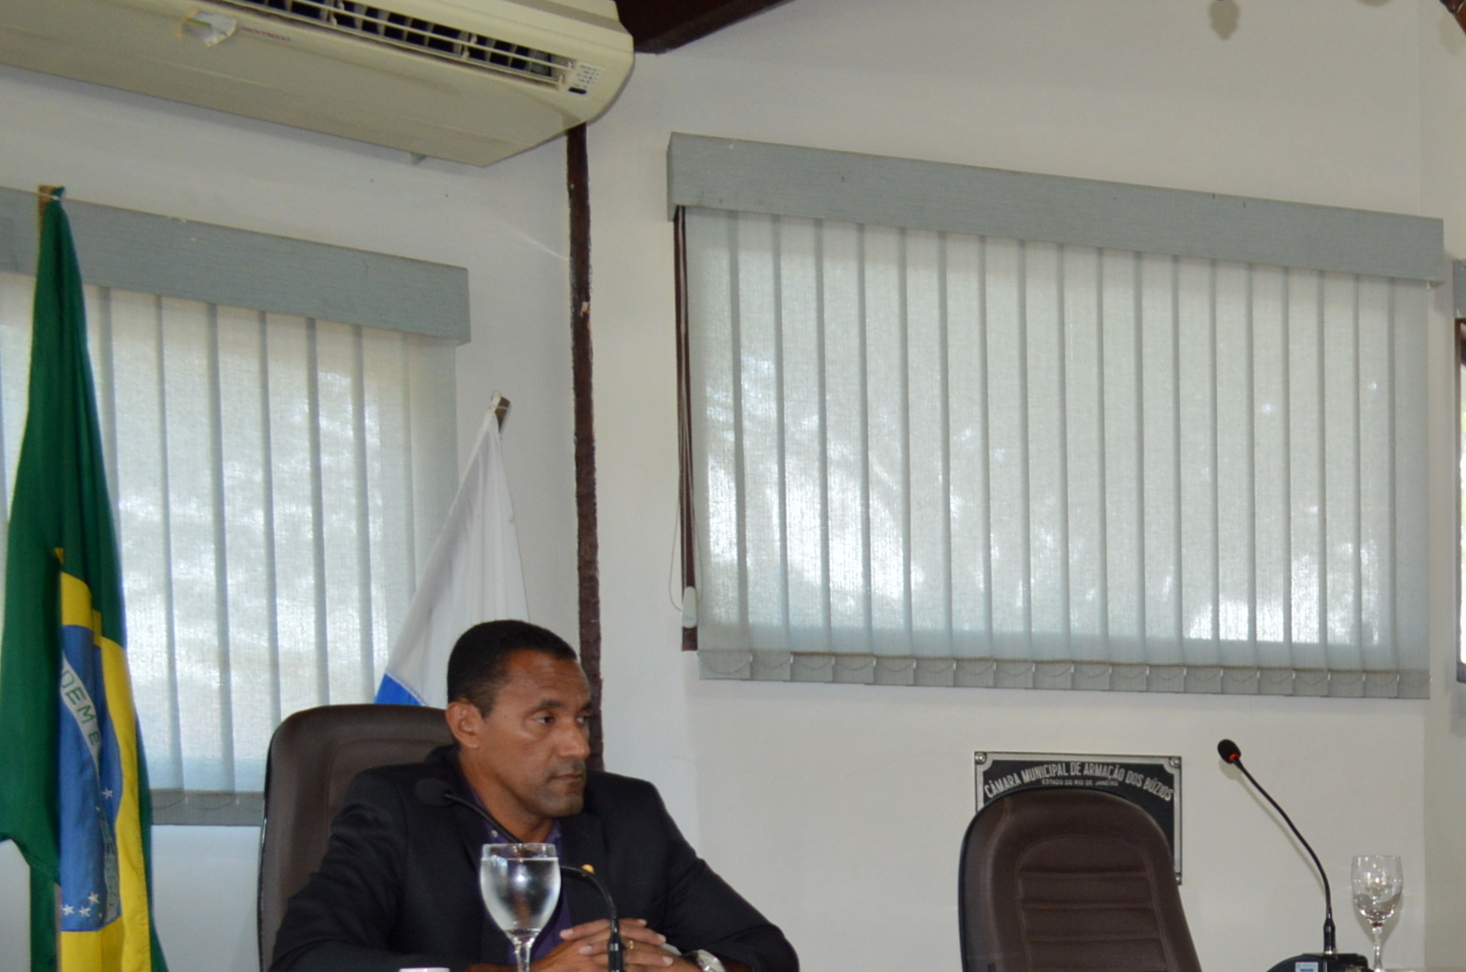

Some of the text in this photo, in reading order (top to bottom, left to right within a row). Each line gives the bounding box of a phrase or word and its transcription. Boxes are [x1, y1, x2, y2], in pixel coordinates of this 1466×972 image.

[984, 762, 1174, 802] CÂMARA MUNICIPAL DE ARMAÇÃO DOS BÚZIOS
